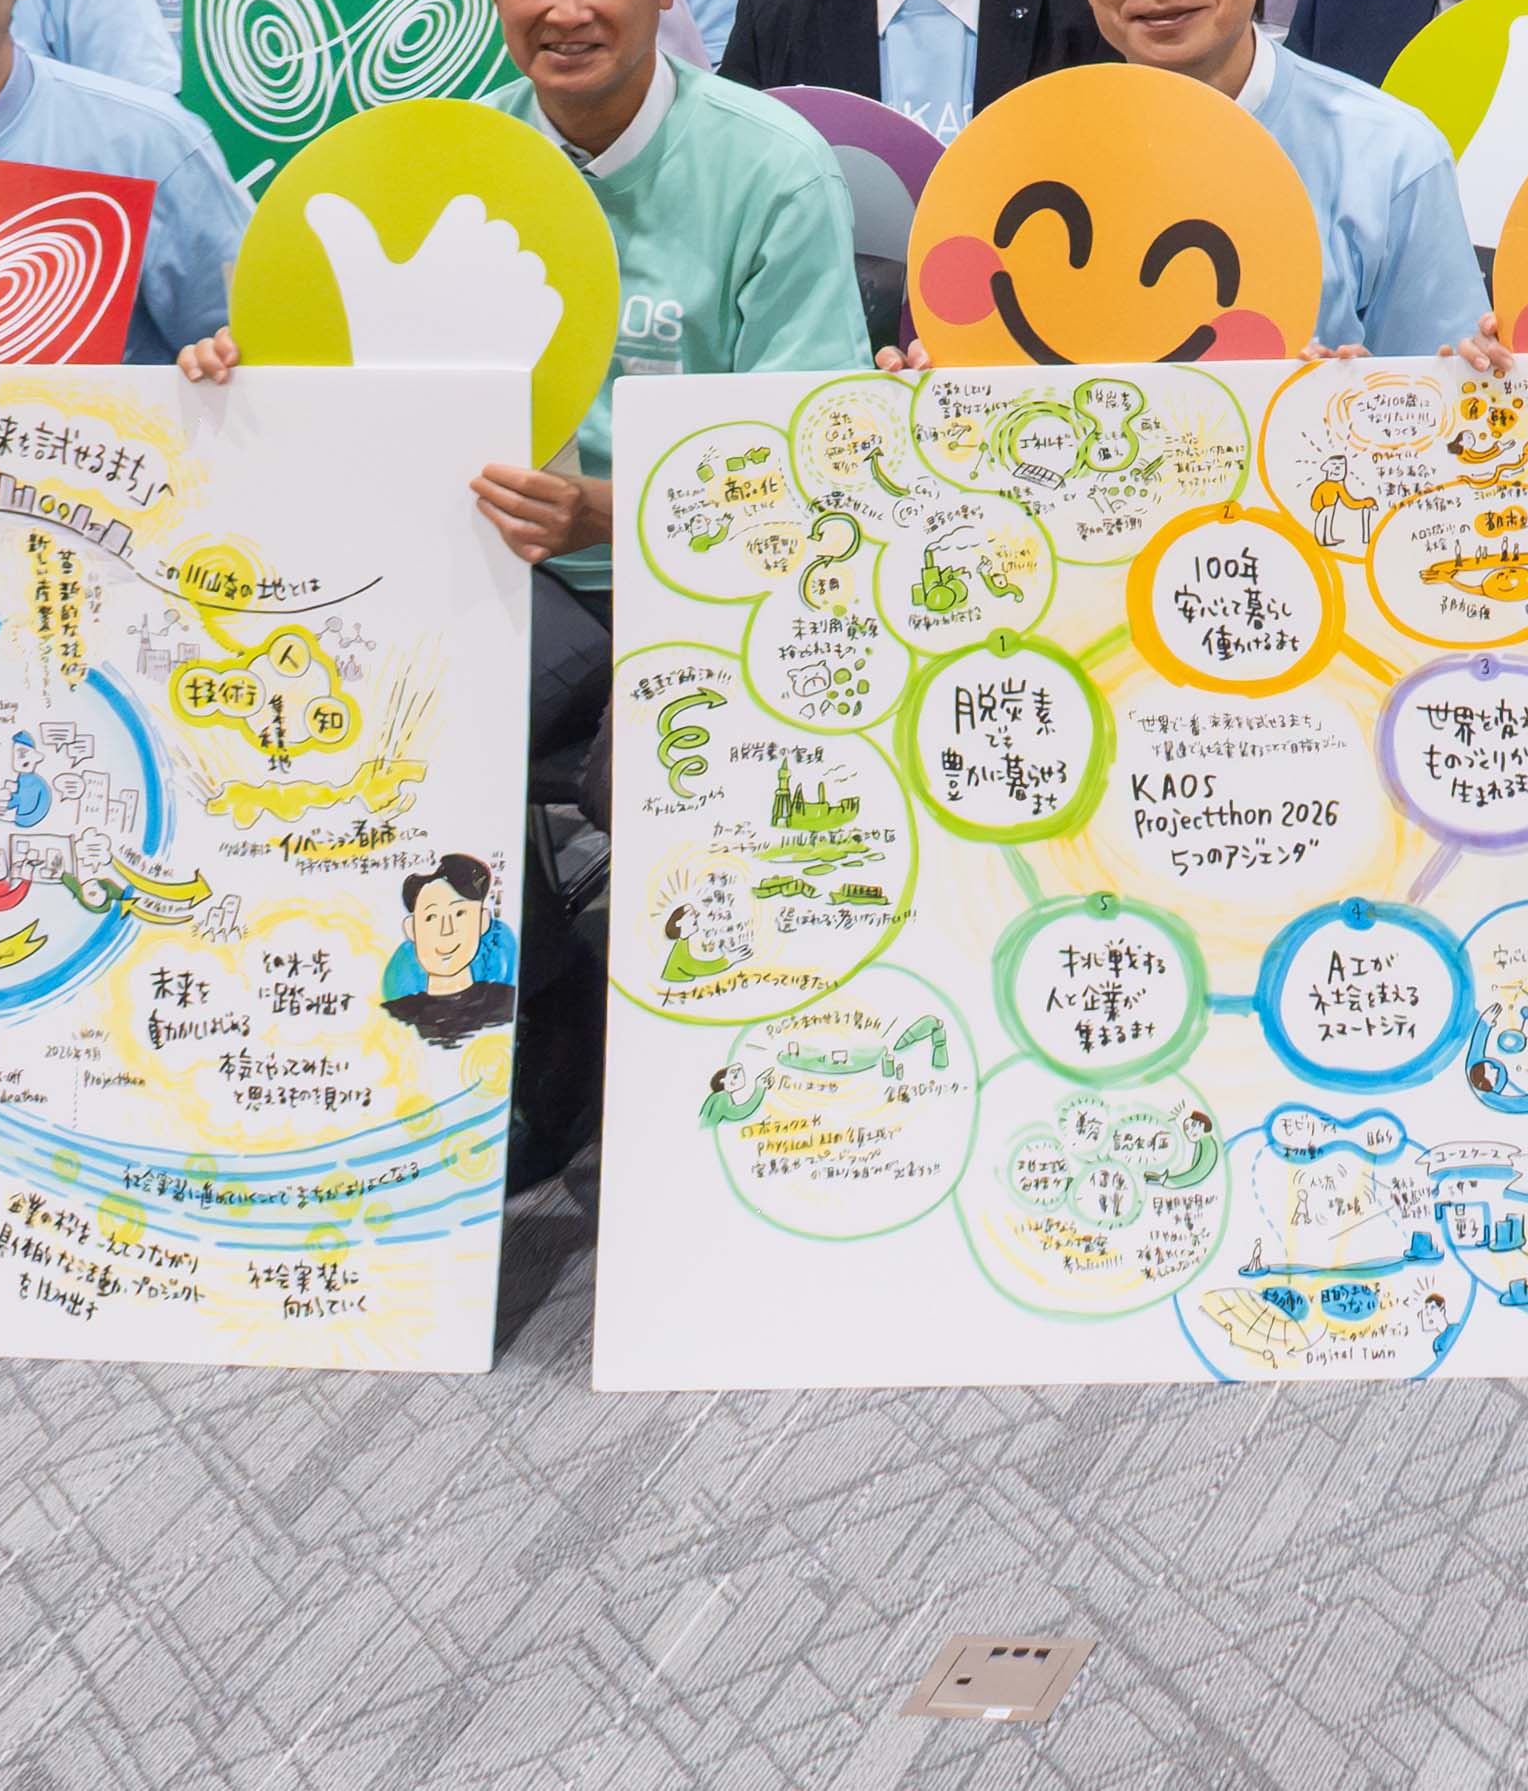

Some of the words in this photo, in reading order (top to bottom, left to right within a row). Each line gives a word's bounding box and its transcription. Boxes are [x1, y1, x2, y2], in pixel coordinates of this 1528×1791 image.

[1194, 548, 1259, 585] 100年
[1174, 587, 1294, 631] 安心して暮らし
[279, 645, 300, 669] 人
[185, 678, 257, 706] 技術
[954, 678, 1056, 735] 脱炭素
[314, 707, 343, 731] 知
[984, 729, 1014, 749] でも
[941, 747, 1068, 802] 豊かに暮らせる
[1131, 772, 1218, 804] KAOS
[1032, 793, 1058, 815] まち
[1134, 798, 1273, 838] Projectthon
[1281, 800, 1340, 828] 2026
[1171, 839, 1320, 877] 5つのアジェンダ
[1060, 939, 1168, 979] 挑戦する
[1326, 949, 1400, 982] AIが
[1045, 980, 1149, 1023] 人と企業が
[1308, 984, 1420, 1015] 社会を支える
[1074, 1019, 1157, 1054] 集まるまち
[1318, 1017, 1418, 1041] スマートシティ
